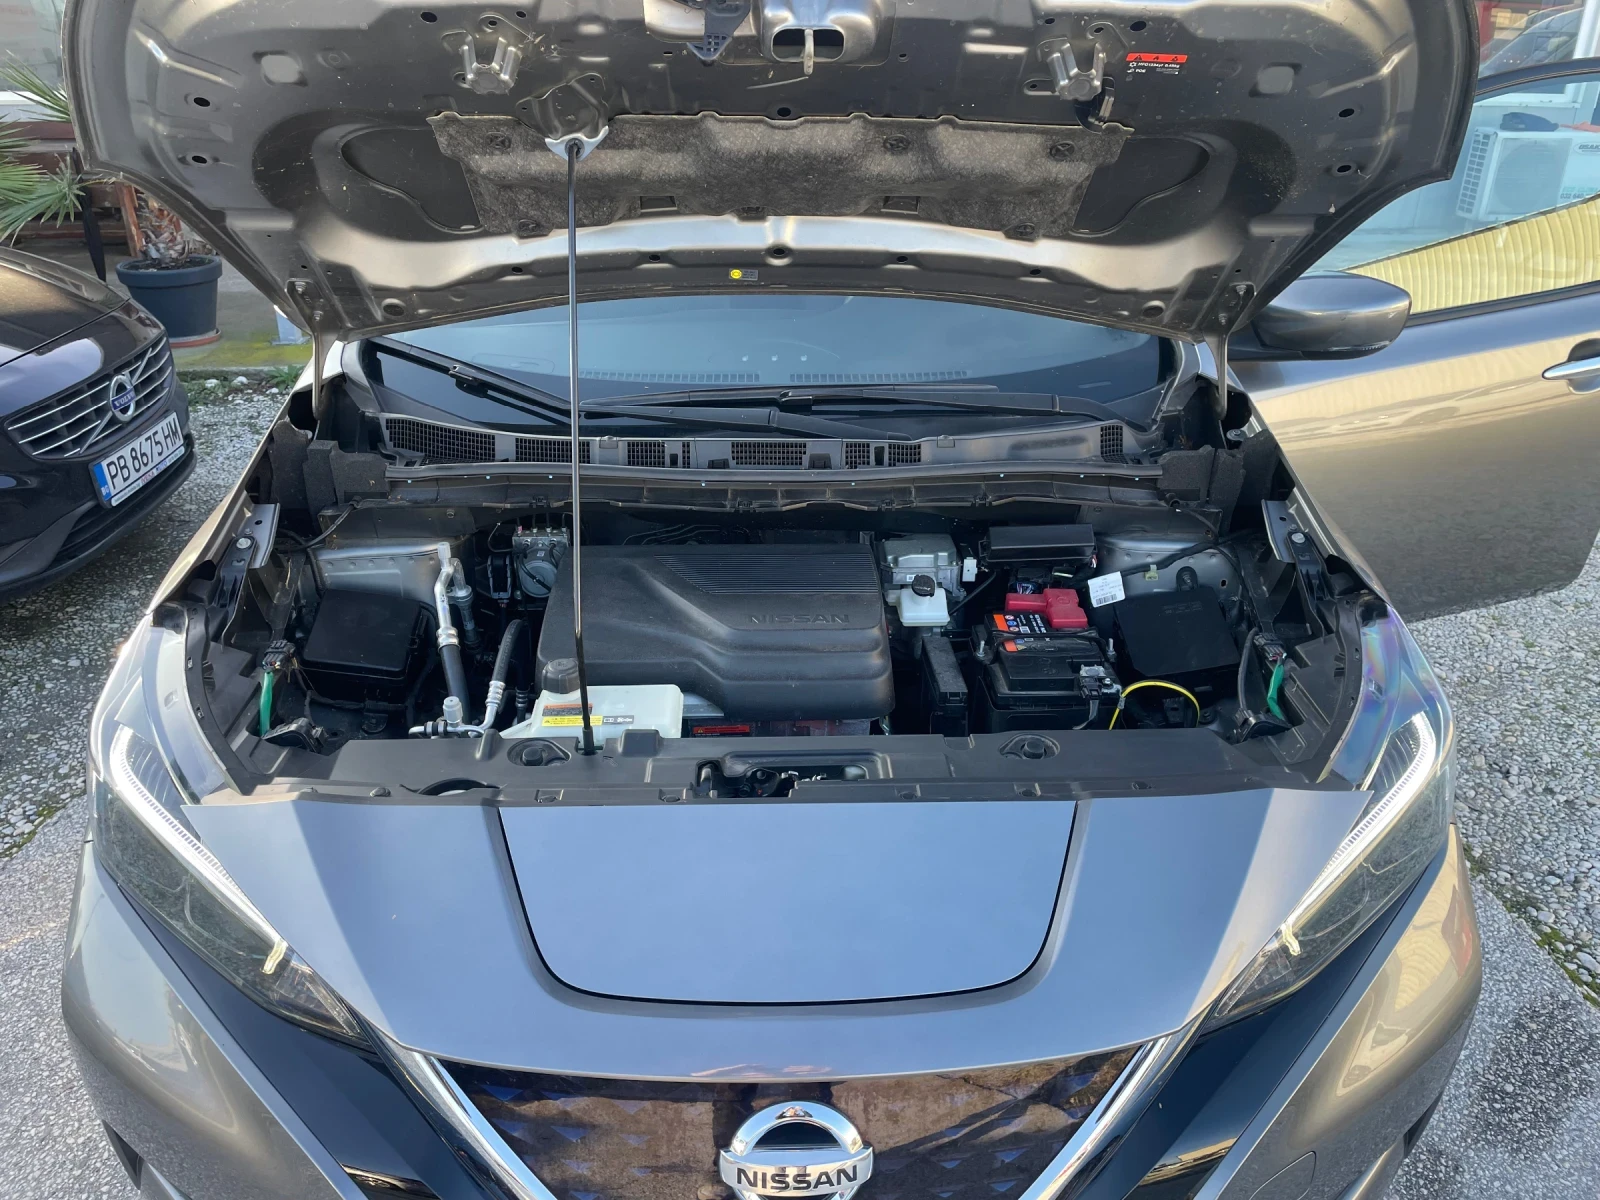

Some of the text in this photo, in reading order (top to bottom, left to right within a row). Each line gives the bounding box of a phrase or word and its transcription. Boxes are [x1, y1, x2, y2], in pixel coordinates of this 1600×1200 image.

[106, 454, 131, 490] PB
[129, 430, 164, 474] 8675
[161, 417, 180, 451] HM
[750, 614, 850, 624] NISSAN
[736, 1165, 858, 1191] NISSAN
